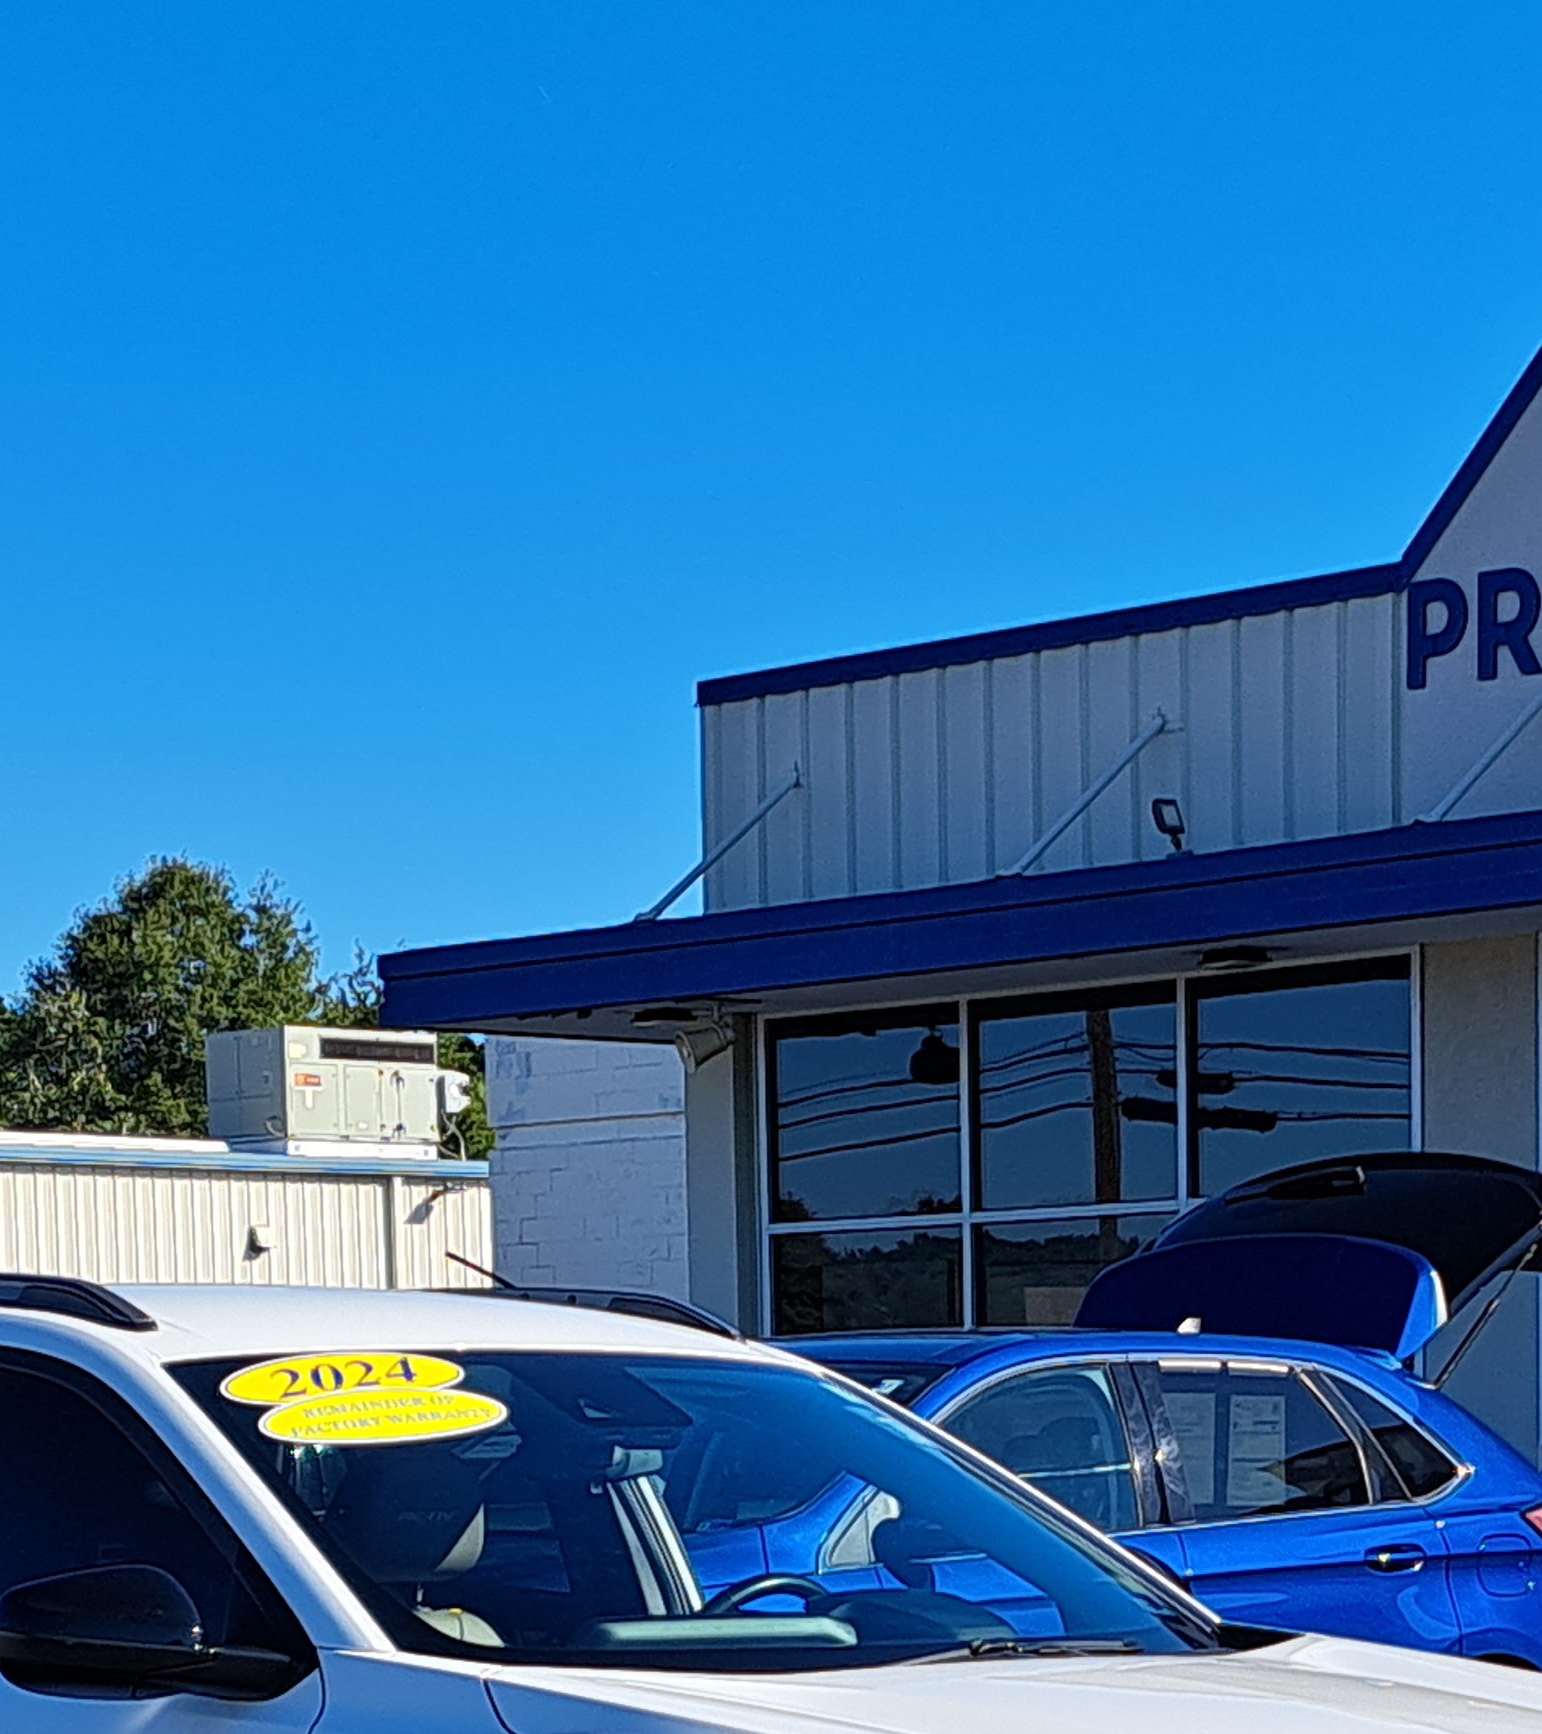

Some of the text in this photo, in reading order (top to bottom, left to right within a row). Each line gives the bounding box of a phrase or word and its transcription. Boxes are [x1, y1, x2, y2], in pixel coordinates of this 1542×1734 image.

[270, 1357, 417, 1399] 2024
[302, 1394, 427, 1419] REMAINDER
[291, 1407, 492, 1438] FACTORY WARRANTY
